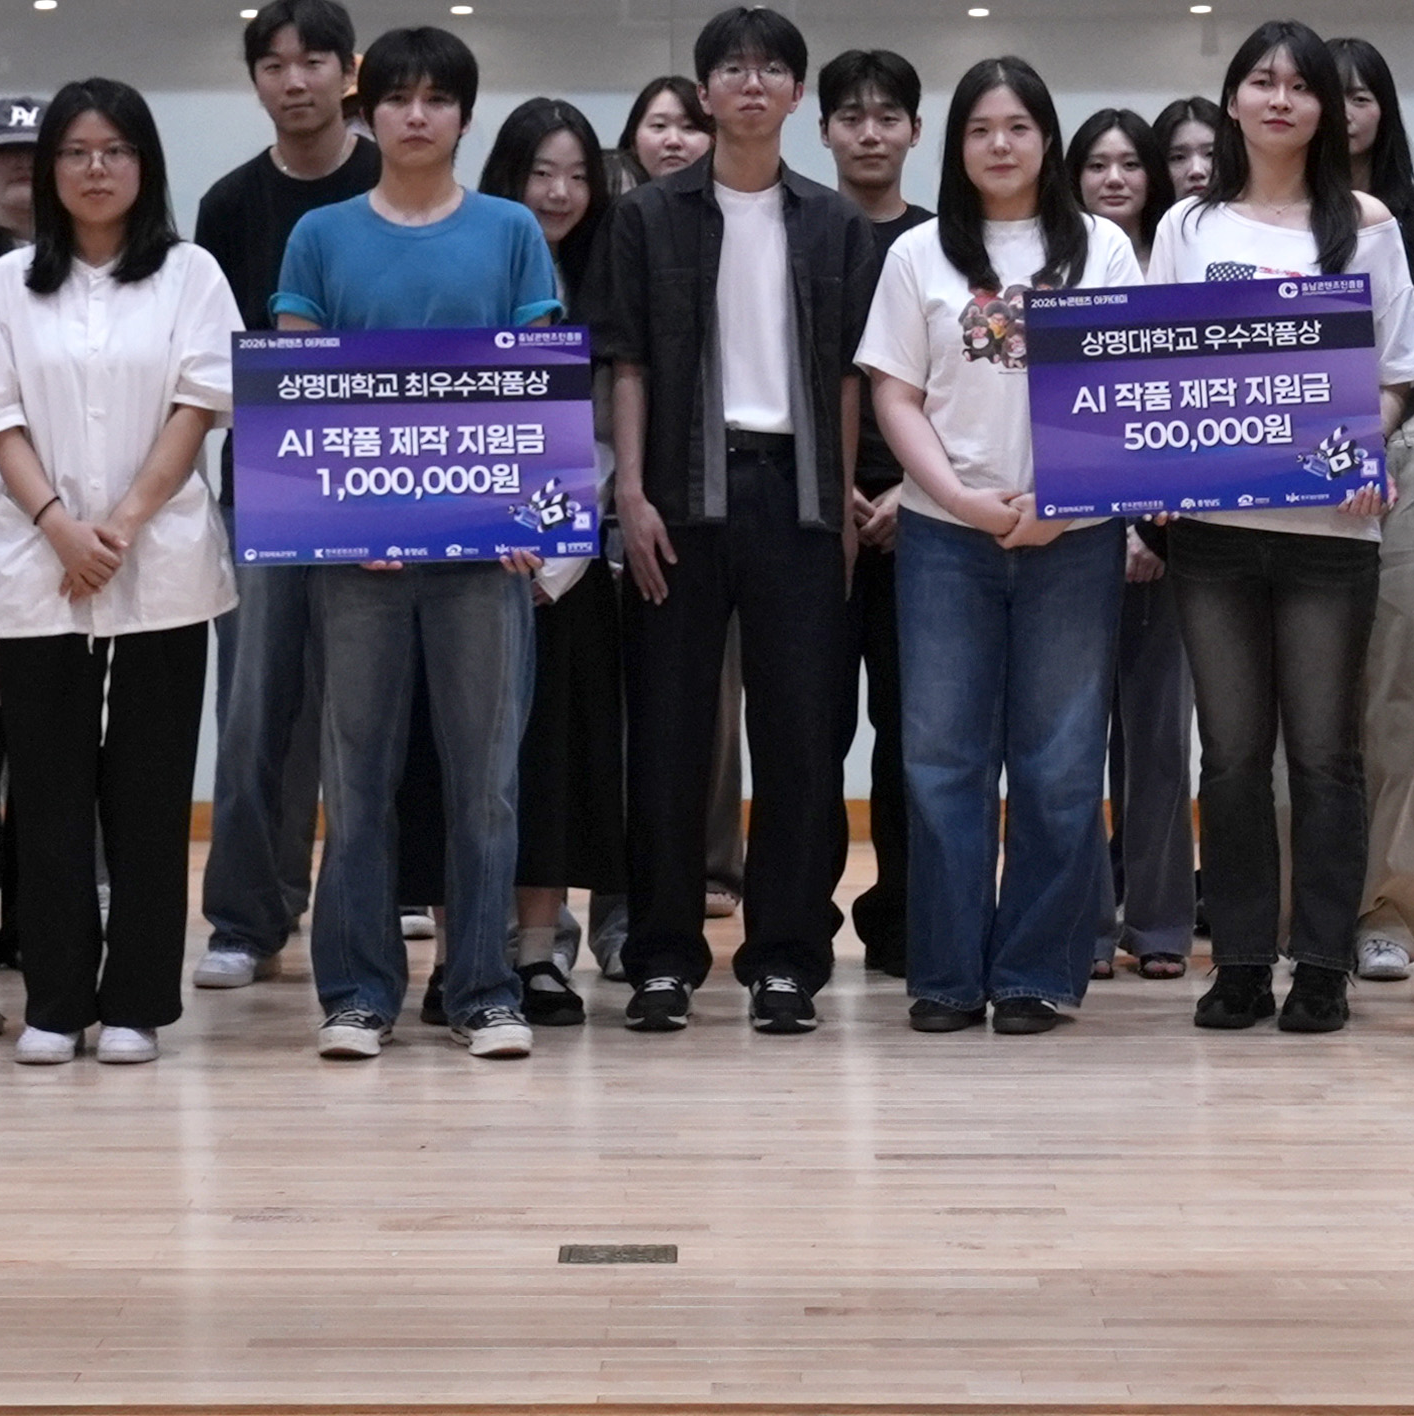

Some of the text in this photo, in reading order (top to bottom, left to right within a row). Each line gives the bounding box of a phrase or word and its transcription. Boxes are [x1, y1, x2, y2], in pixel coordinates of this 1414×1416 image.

[1030, 297, 1058, 309] 2026
[239, 338, 267, 349] 2026
[1080, 319, 1322, 357] 상명대학교 우수작품상
[277, 370, 550, 400] 상명대학교 최우수작품상
[1071, 372, 1331, 415] AI 작품 제작 지원금
[277, 423, 545, 458] AI 작품 제작 지원금
[1124, 413, 1293, 452] 500,000원
[316, 463, 521, 501] 1,000,000원
